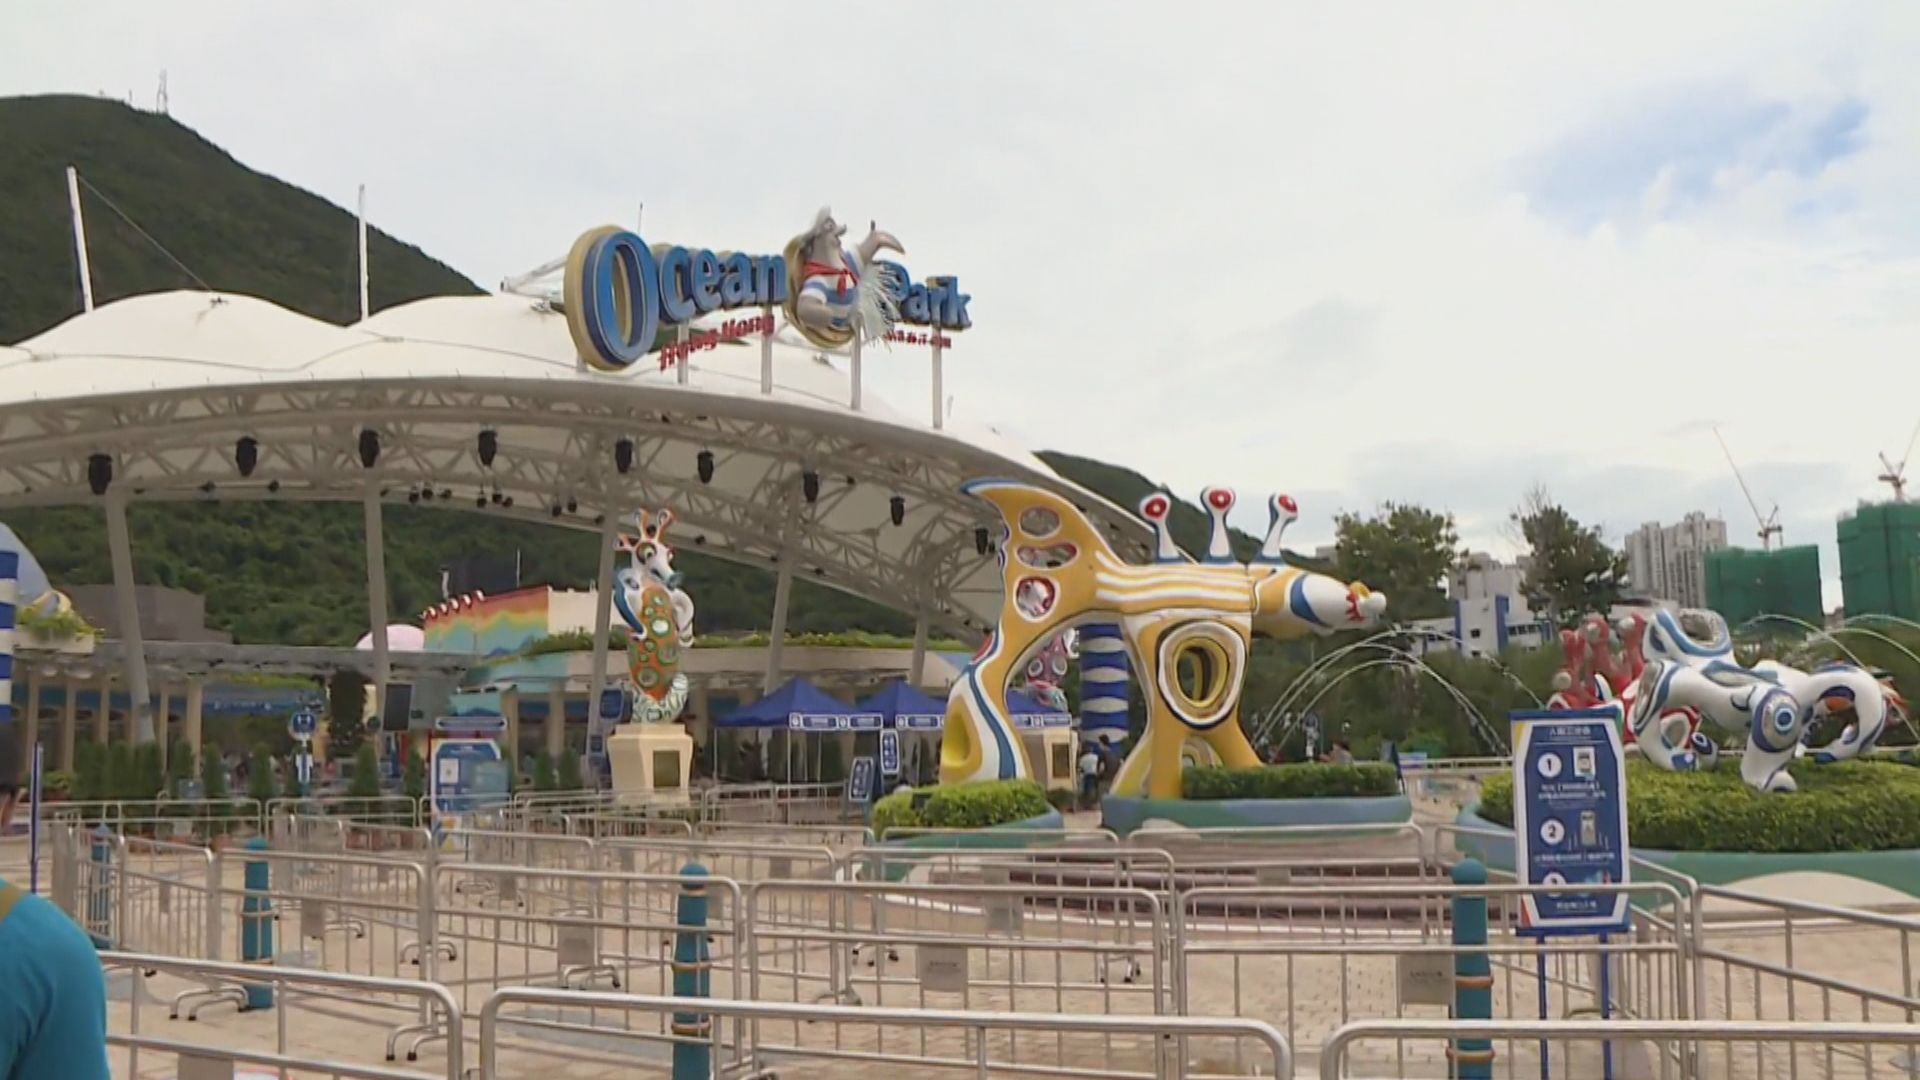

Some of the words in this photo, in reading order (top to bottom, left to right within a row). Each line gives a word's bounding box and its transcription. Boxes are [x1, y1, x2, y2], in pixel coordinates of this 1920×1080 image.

[564, 225, 788, 371] Ocean
[878, 260, 972, 331] Park
[1547, 823, 1557, 840] 2
